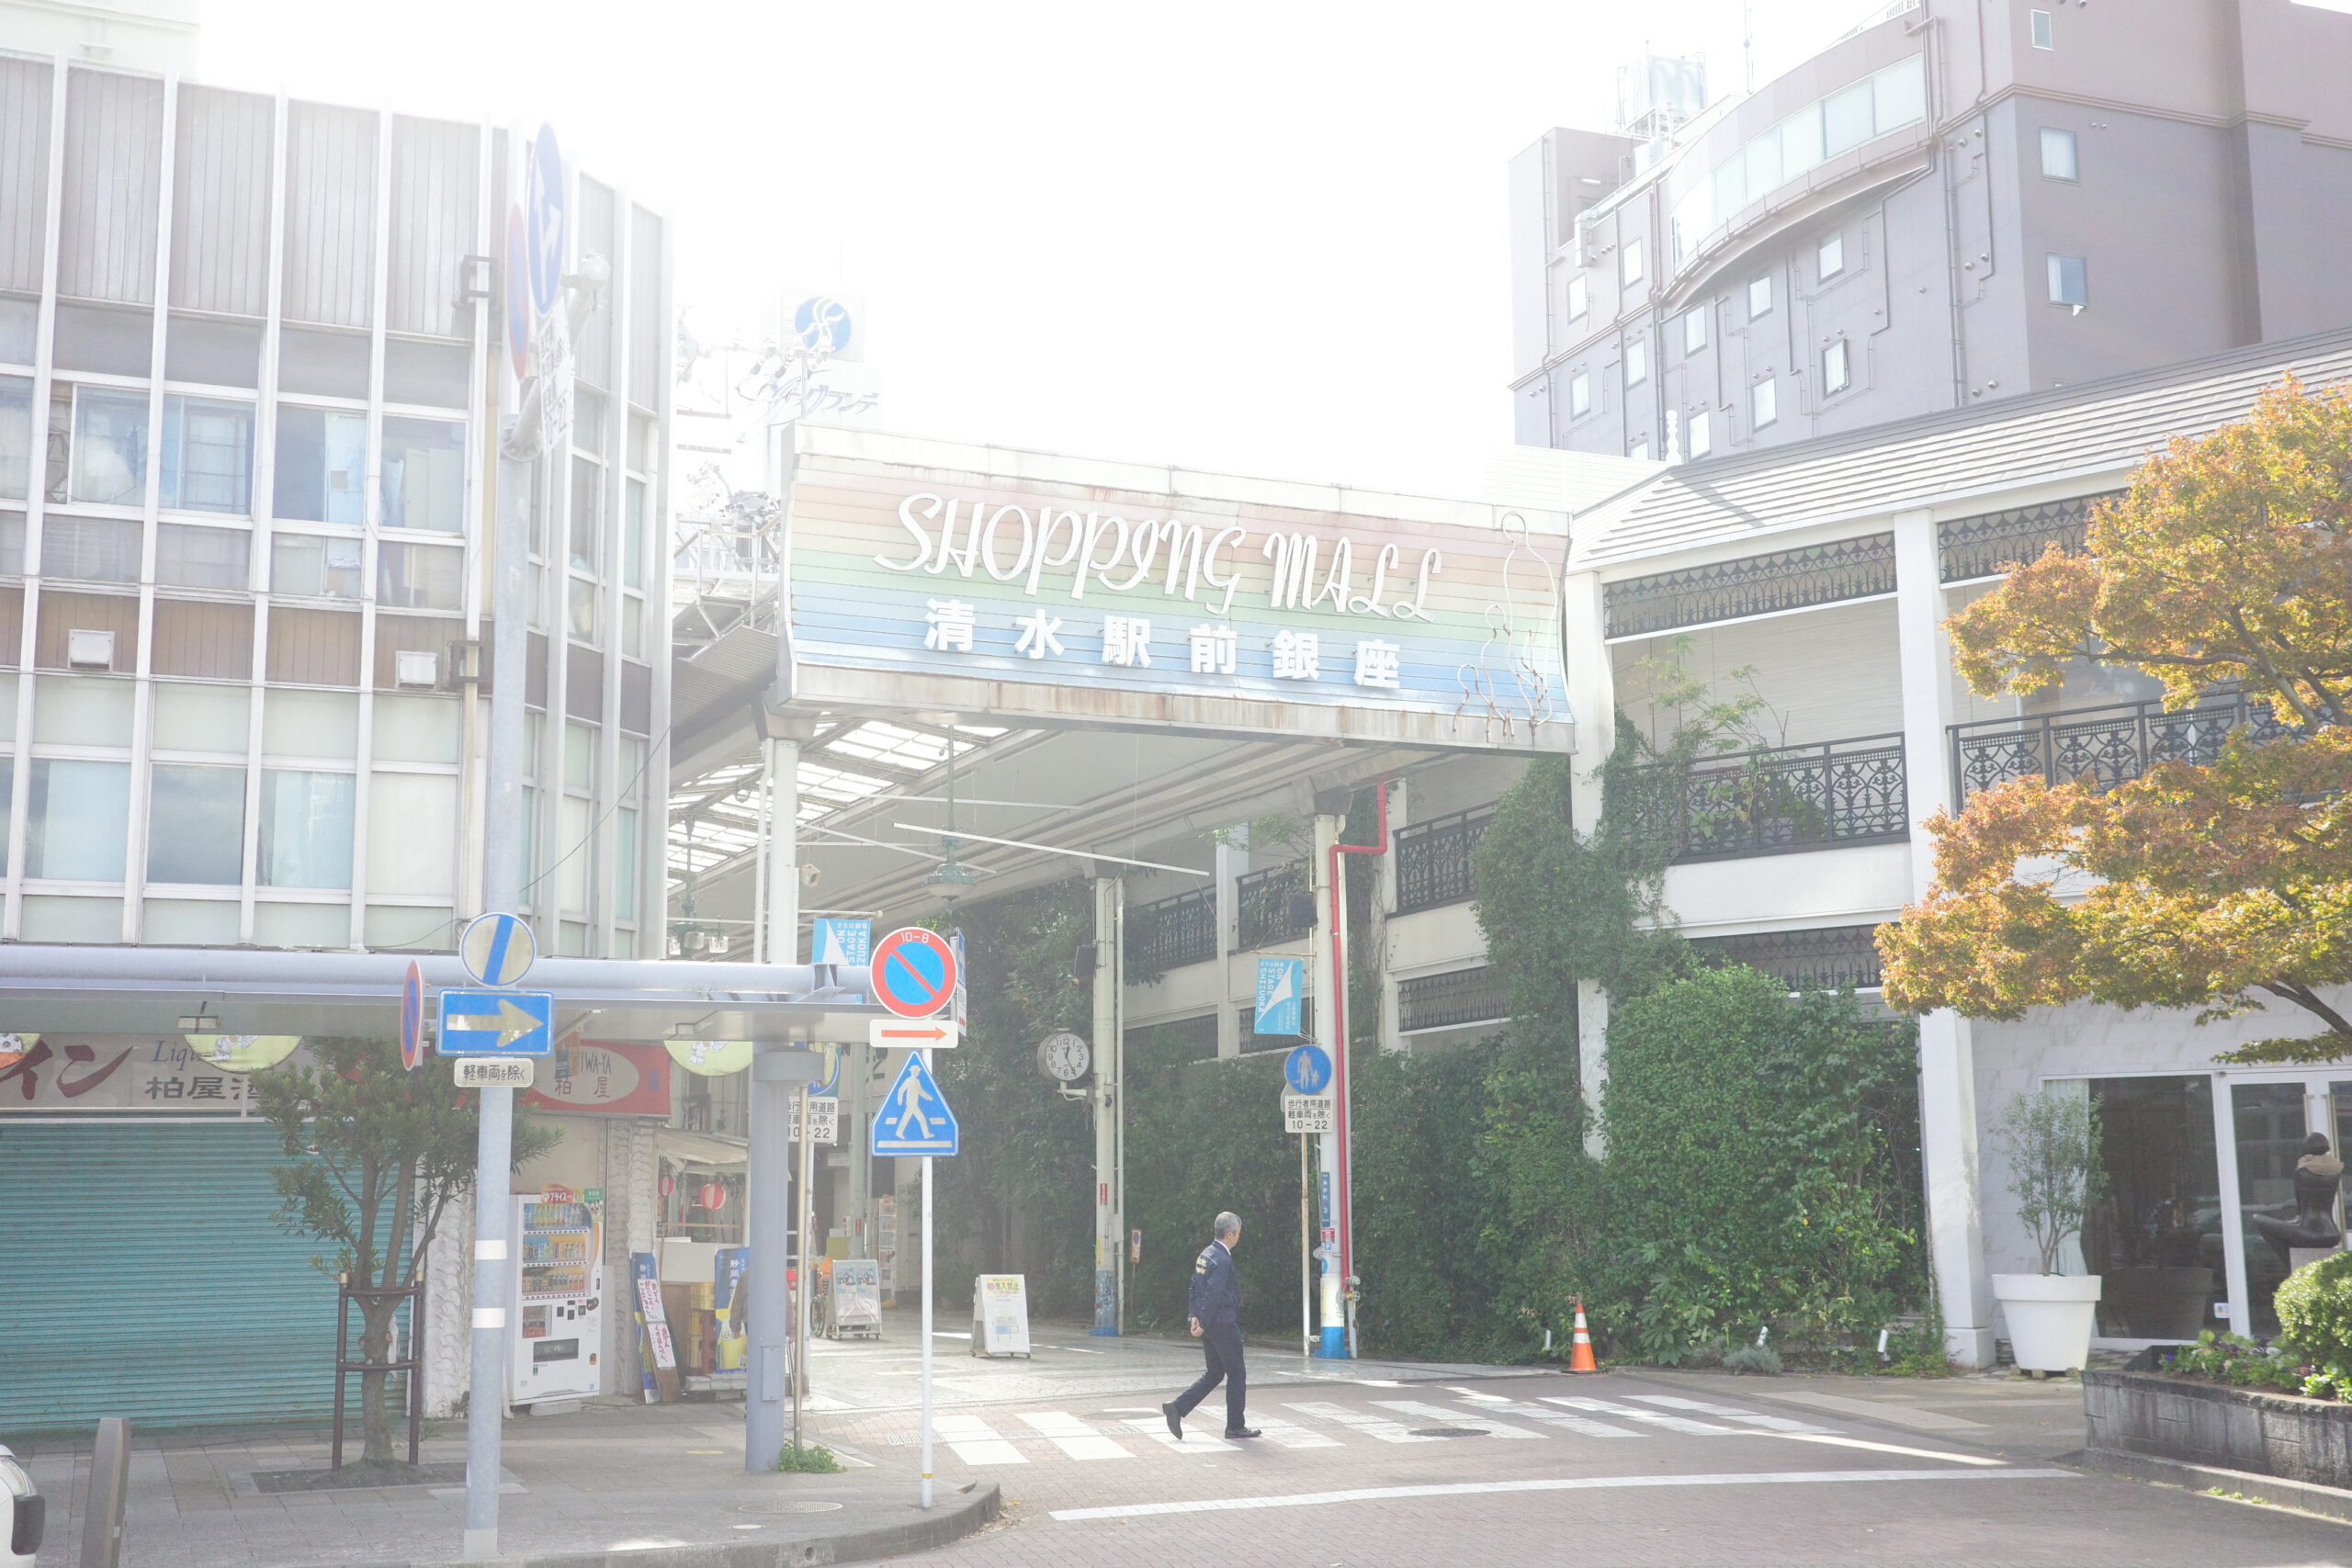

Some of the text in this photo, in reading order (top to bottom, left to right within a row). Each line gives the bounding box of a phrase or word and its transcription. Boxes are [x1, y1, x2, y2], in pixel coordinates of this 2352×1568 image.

[873, 492, 1443, 621] SHOPPING MALL
[924, 598, 1400, 688] 清水駅前銀座
[900, 931, 930, 944] 10-8
[1258, 967, 1268, 1013] SHIZUOKA
[462, 1064, 526, 1081] 軽車両を除く
[788, 1101, 836, 1113] 行用道路
[1287, 1099, 1331, 1109] 歩行者用道路
[1287, 1110, 1331, 1120] 軽車両を除く
[1292, 1120, 1329, 1130] 10-22
